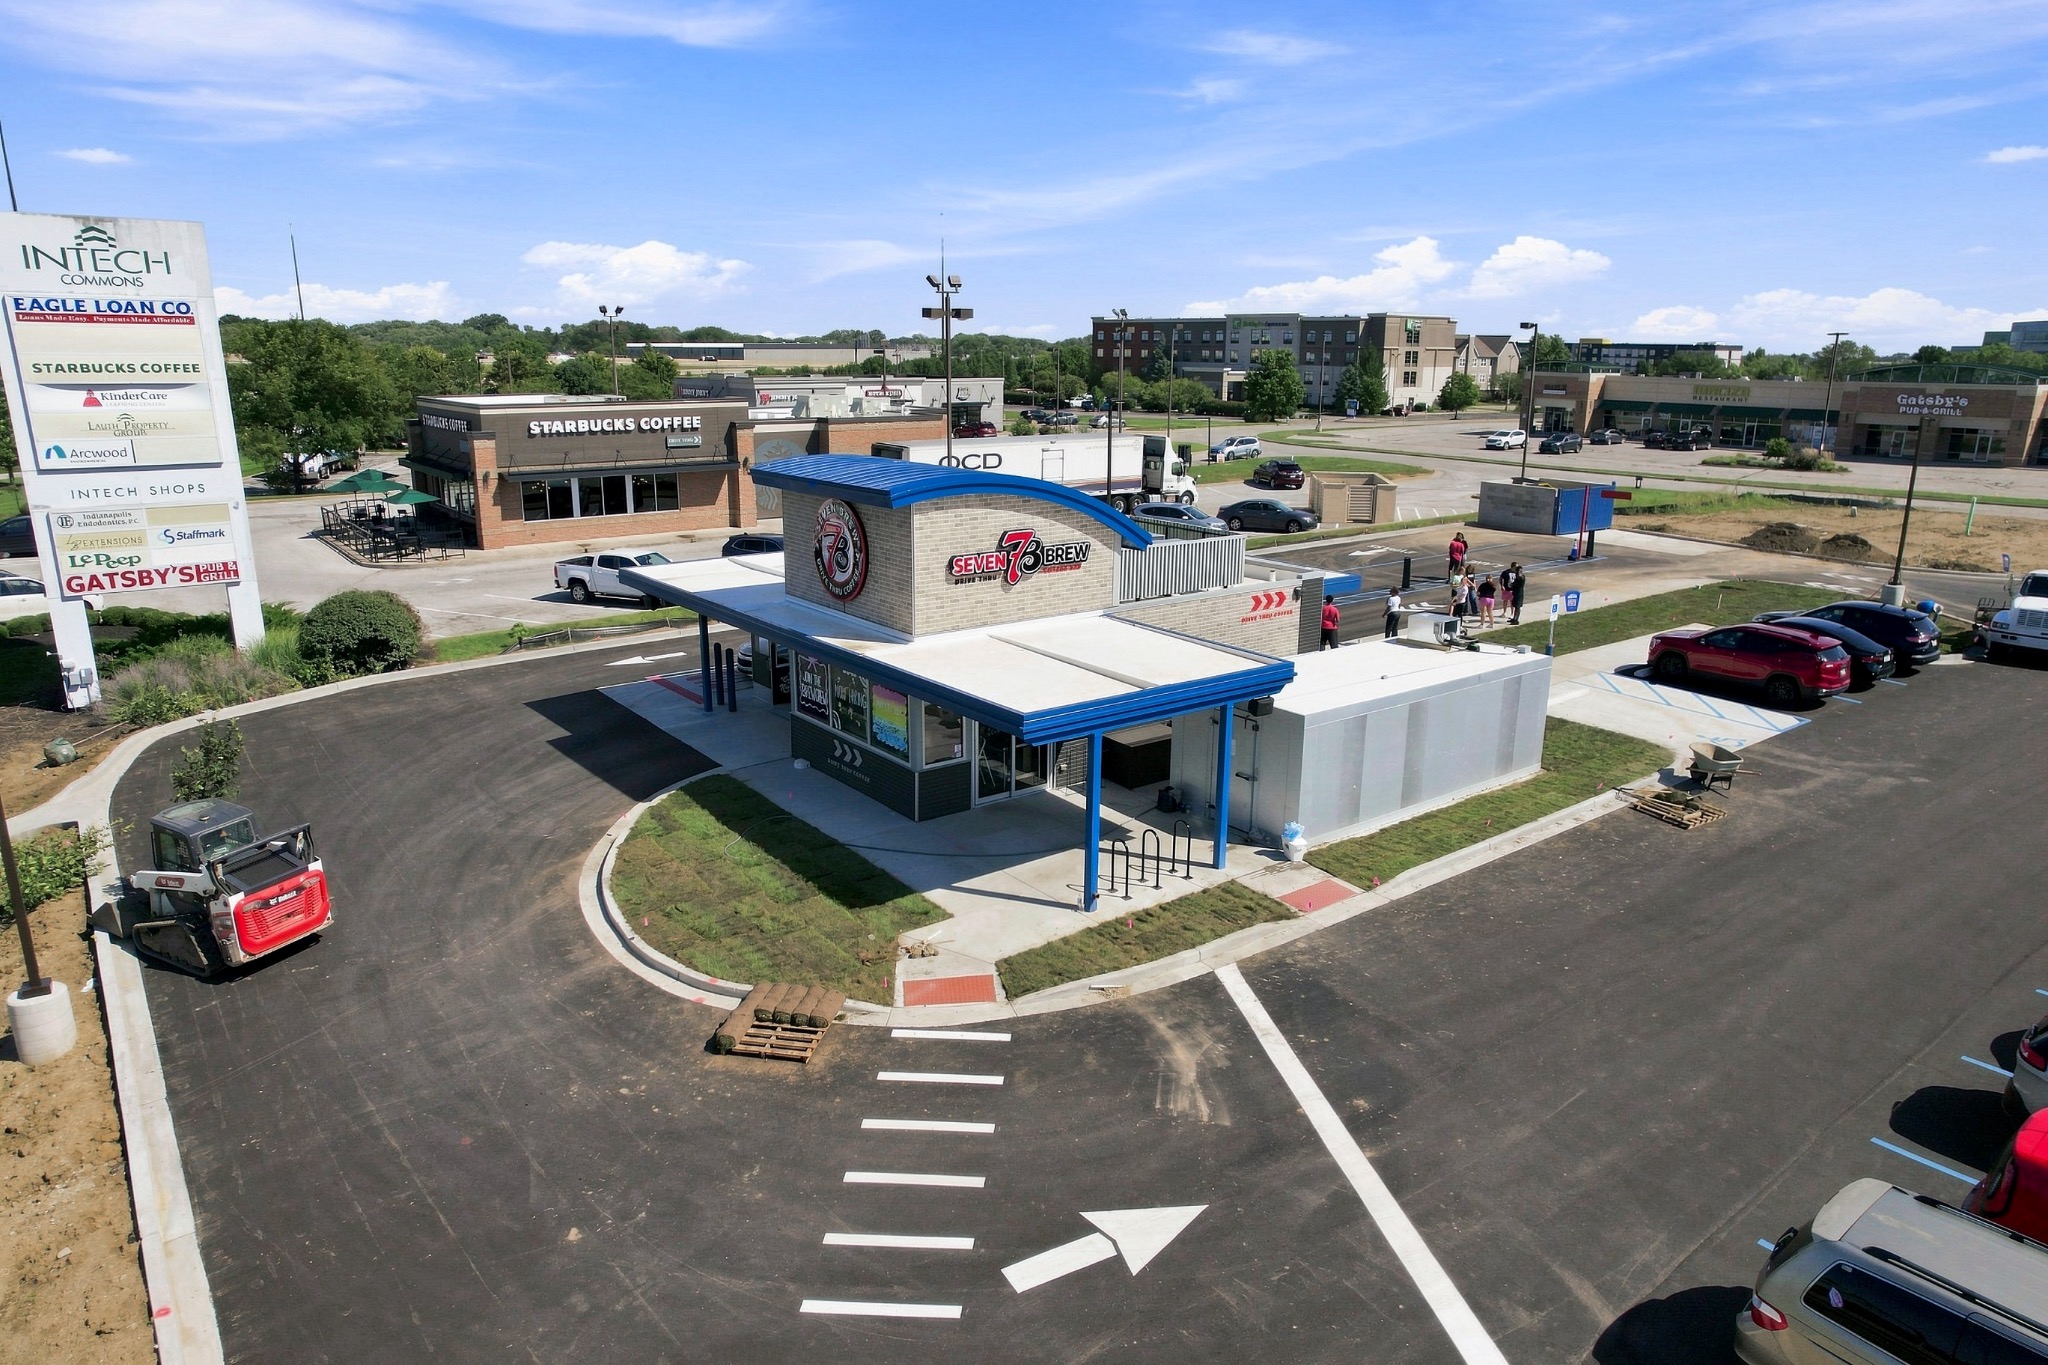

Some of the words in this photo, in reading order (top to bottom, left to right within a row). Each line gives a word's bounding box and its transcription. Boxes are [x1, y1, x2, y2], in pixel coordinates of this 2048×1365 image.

[22, 244, 171, 274] INTECH
[60, 274, 144, 288] COMMONS
[13, 298, 87, 312] EAGLE
[94, 300, 155, 314] LOAN
[161, 301, 194, 315] CO.
[32, 363, 136, 374] STARBUCKS
[140, 363, 201, 374] COFFEE
[100, 391, 168, 401] KinderCare
[1896, 394, 1968, 407] Gatsby's
[1900, 406, 1920, 414] PUB
[1932, 408, 1962, 416] GRILL
[529, 417, 636, 435] STARBUCKS
[639, 416, 701, 430] COFFEE
[113, 429, 147, 437] GROUP
[70, 447, 128, 458] Arcwood
[70, 487, 138, 500] INTECH
[150, 483, 206, 496] SHOPS
[83, 512, 132, 520] Indianapolis
[176, 528, 225, 541] Staffmark
[83, 536, 143, 548] EXTENSIONS
[952, 551, 1007, 576] SEVEN
[1044, 542, 1090, 566] BREW
[200, 562, 224, 573] PUB
[227, 561, 237, 570] &
[66, 565, 195, 594] GATSBY'S
[200, 570, 238, 582] GRILL
[954, 578, 976, 586] DRIVE
